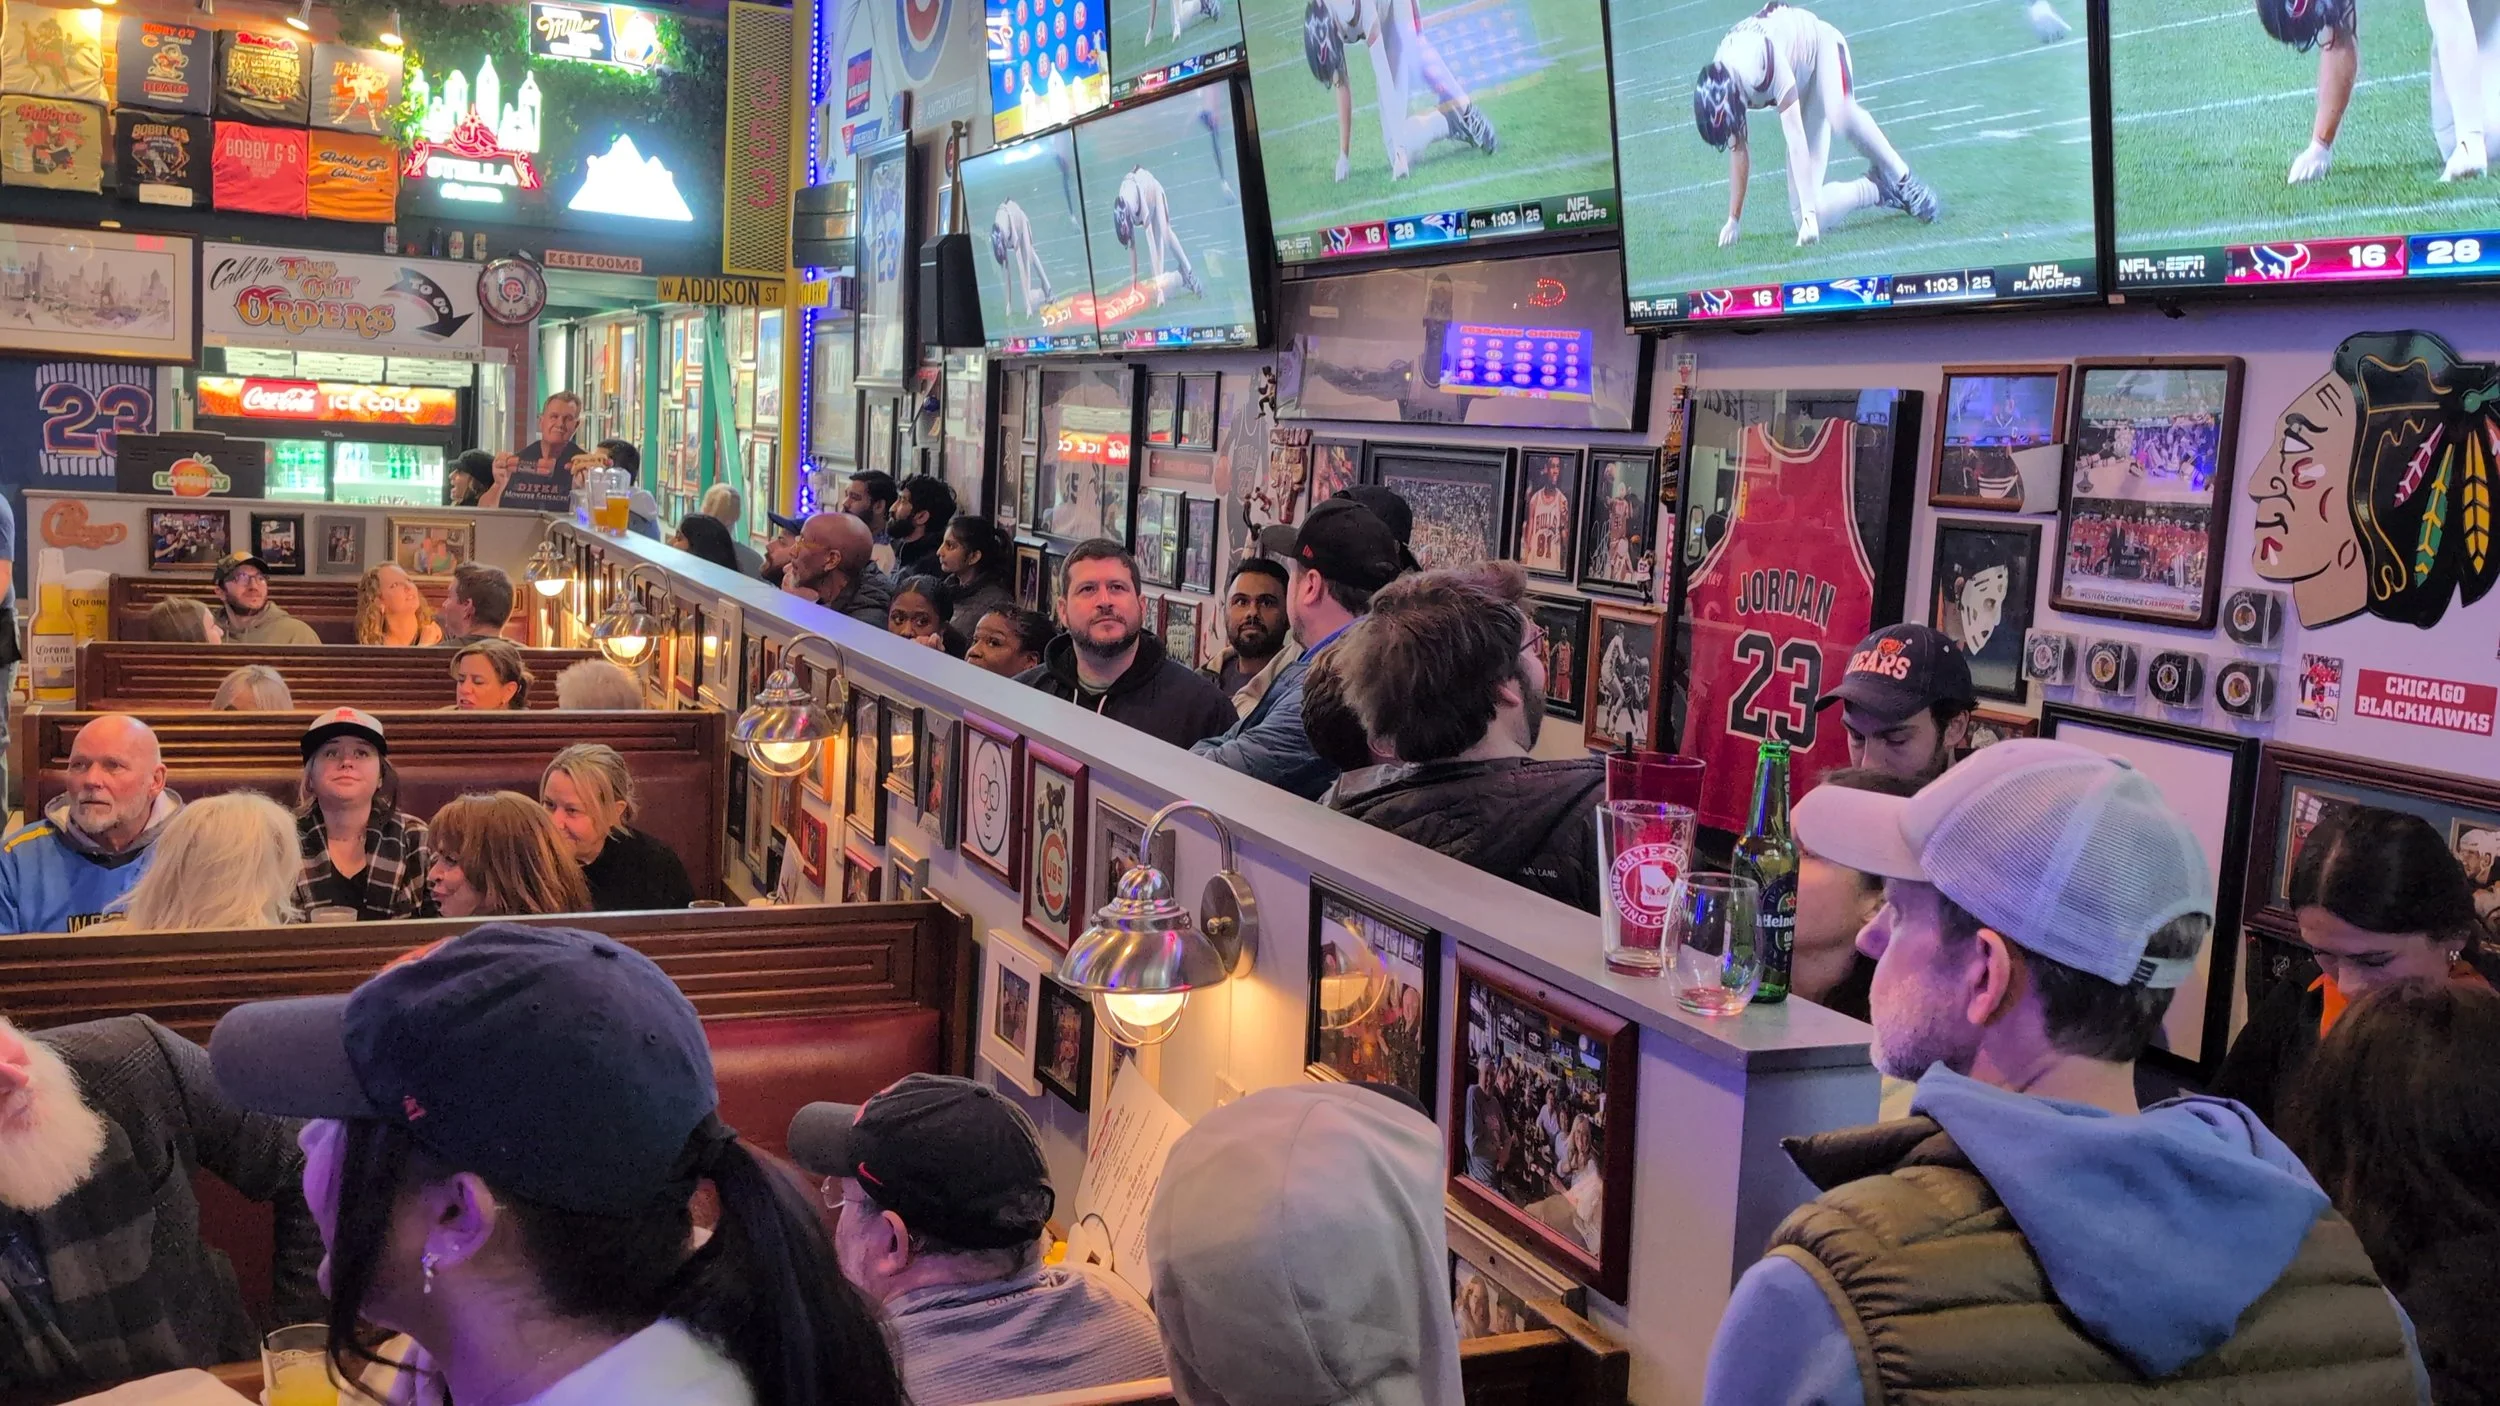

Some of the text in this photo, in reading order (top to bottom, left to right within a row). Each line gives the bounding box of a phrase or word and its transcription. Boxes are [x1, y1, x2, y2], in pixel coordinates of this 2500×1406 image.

[536, 16, 600, 41] Miller
[226, 139, 270, 160] BOBBY
[1365, 197, 1594, 244] 16 28 4TH 1:03 25 NFL
[1556, 208, 1607, 225] PLAYOFFS
[548, 252, 640, 272] RESTROOMS
[2119, 257, 2157, 274] NFL
[2165, 255, 2205, 272] ESPN
[2348, 244, 2387, 269] 16
[2425, 238, 2481, 264] 28
[210, 257, 252, 291] Call
[1753, 264, 2064, 307] 16 28 4TH 1:03 25 NFL
[2013, 275, 2082, 292] PLAYOFFS
[2119, 271, 2206, 281] DIVISIONAL
[662, 276, 778, 306] W ADDISON ST
[1630, 298, 1678, 312] NFL ESPN
[328, 395, 361, 410] ICE
[366, 396, 421, 413] COLD
[157, 473, 226, 488] LOTTERY
[1535, 510, 1558, 533] BULLS
[72, 598, 106, 608] Corona
[1736, 567, 1836, 631] JORDAN
[2079, 591, 2185, 610] WESTERN CONFERENCE CHAMPIONS
[36, 644, 71, 655] Corona
[1726, 629, 1824, 754] 23
[2385, 675, 2466, 704] CHICAGO
[2357, 695, 2491, 733] BLACKHAWKS
[1616, 845, 1660, 872] GATE
[1612, 873, 1649, 925] BREWING
